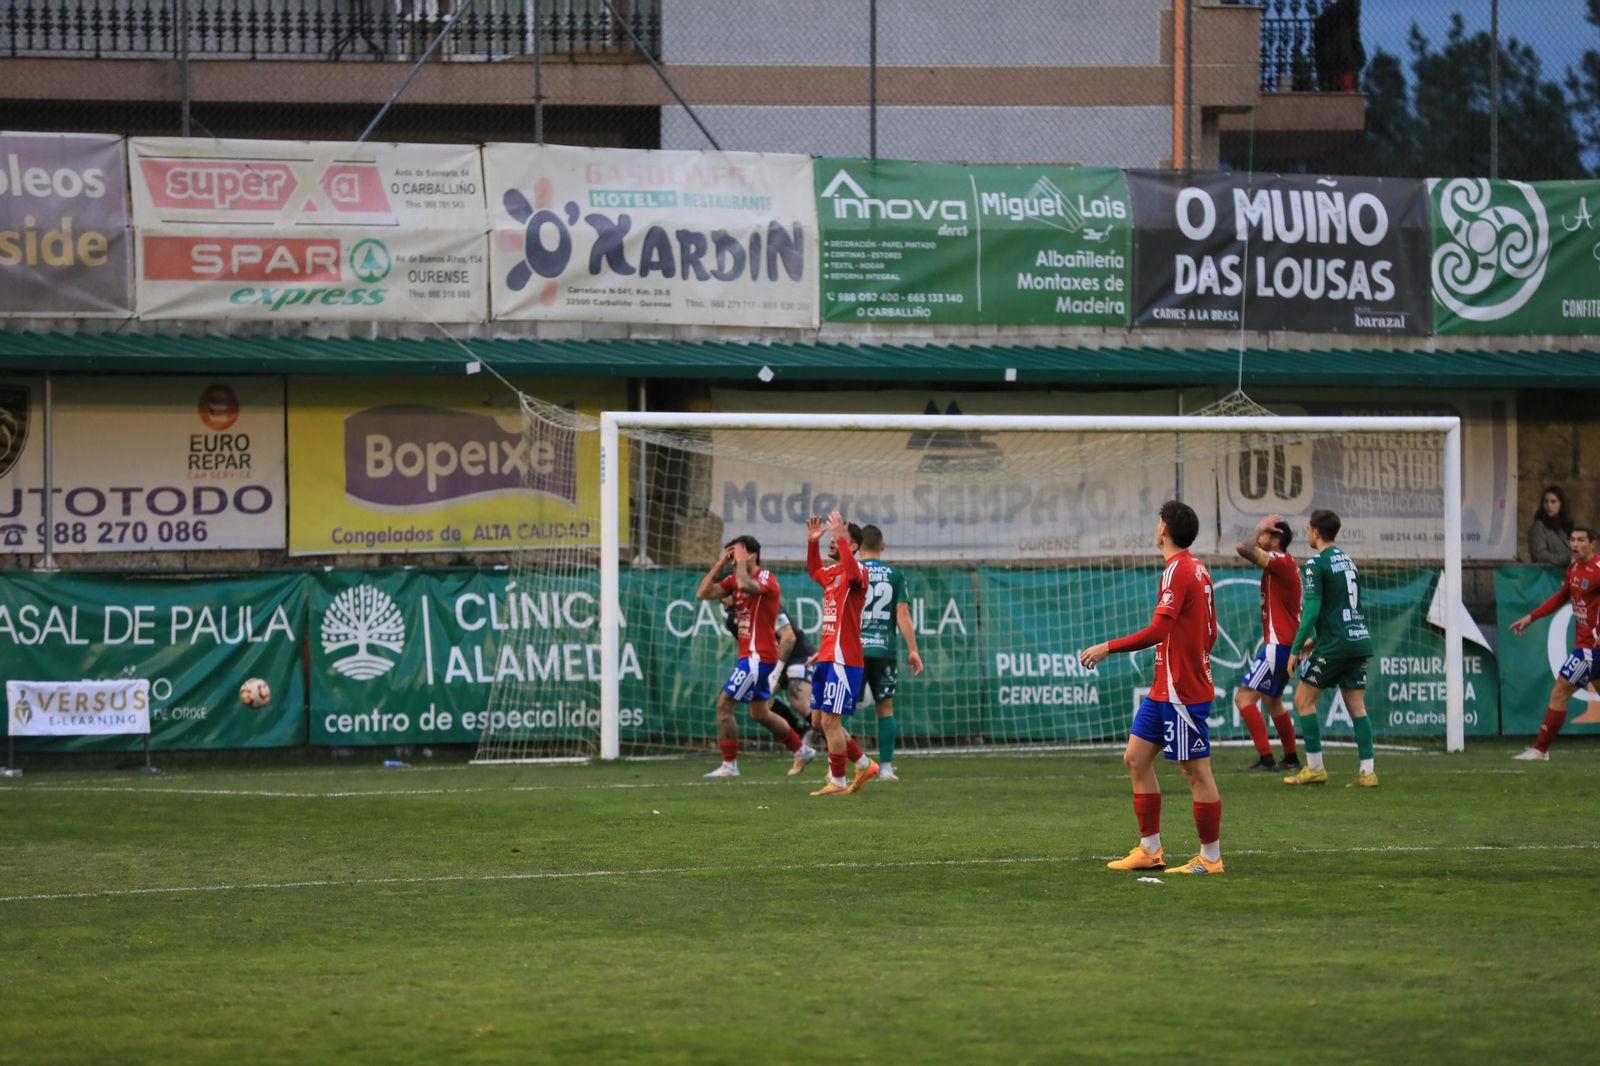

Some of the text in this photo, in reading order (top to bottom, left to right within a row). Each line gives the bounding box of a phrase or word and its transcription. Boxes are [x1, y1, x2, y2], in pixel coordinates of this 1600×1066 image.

[391, 181, 476, 195] O CARBALLIÑO
[592, 192, 773, 210] HOTEL RESTAURANTE
[834, 194, 968, 221] innova
[981, 192, 1127, 222] Miguel Lois
[1176, 178, 1389, 246] O MUIÑO
[882, 241, 904, 249] PAPEL
[191, 243, 338, 274] SPAR
[830, 251, 866, 259] CORTINAS
[1036, 249, 1125, 269] Albañilería
[860, 262, 885, 270] HOGAR
[408, 270, 470, 283] OURENSE
[865, 273, 901, 281] INTEGRAL
[1017, 272, 1125, 291] Montaxes de
[1175, 254, 1396, 301] DAS LOUSAS
[229, 287, 388, 312] express
[837, 292, 856, 302] 988
[858, 293, 878, 302] 092
[880, 293, 899, 302] 400
[946, 294, 963, 303] 140
[1055, 295, 1125, 315] Madeira
[857, 306, 932, 317] O CARBALLIÑO
[1153, 307, 1240, 322] CARNES A LA BRASA
[1354, 313, 1406, 329] barazal
[189, 433, 250, 452] EURO
[188, 453, 251, 470] REPAR
[365, 434, 556, 493] Bopeixe
[1342, 450, 1446, 490] CRISTOB
[187, 470, 252, 480] CAR SERVICE
[723, 481, 899, 525] Maderas
[1342, 495, 1445, 512] CONSTRUCCIONE
[97, 521, 148, 544] 270
[158, 520, 208, 543] 086
[331, 522, 591, 548] Congelados de ALTA CALIDAD
[1018, 537, 1079, 552] OURENSE
[1344, 570, 1358, 610] 5
[455, 580, 627, 631] CLÍNIC
[104, 606, 155, 645] DE
[170, 604, 295, 645] PAULA
[1564, 653, 1581, 672] 19
[730, 667, 747, 686] 18
[37, 689, 146, 715] VERSUS
[999, 682, 1100, 705] CERVECERÍA
[49, 715, 137, 726] E-LEARNING
[172, 707, 208, 720] ORIXE
[324, 700, 644, 735] centro de especialidaes
[1164, 721, 1175, 742] 3
